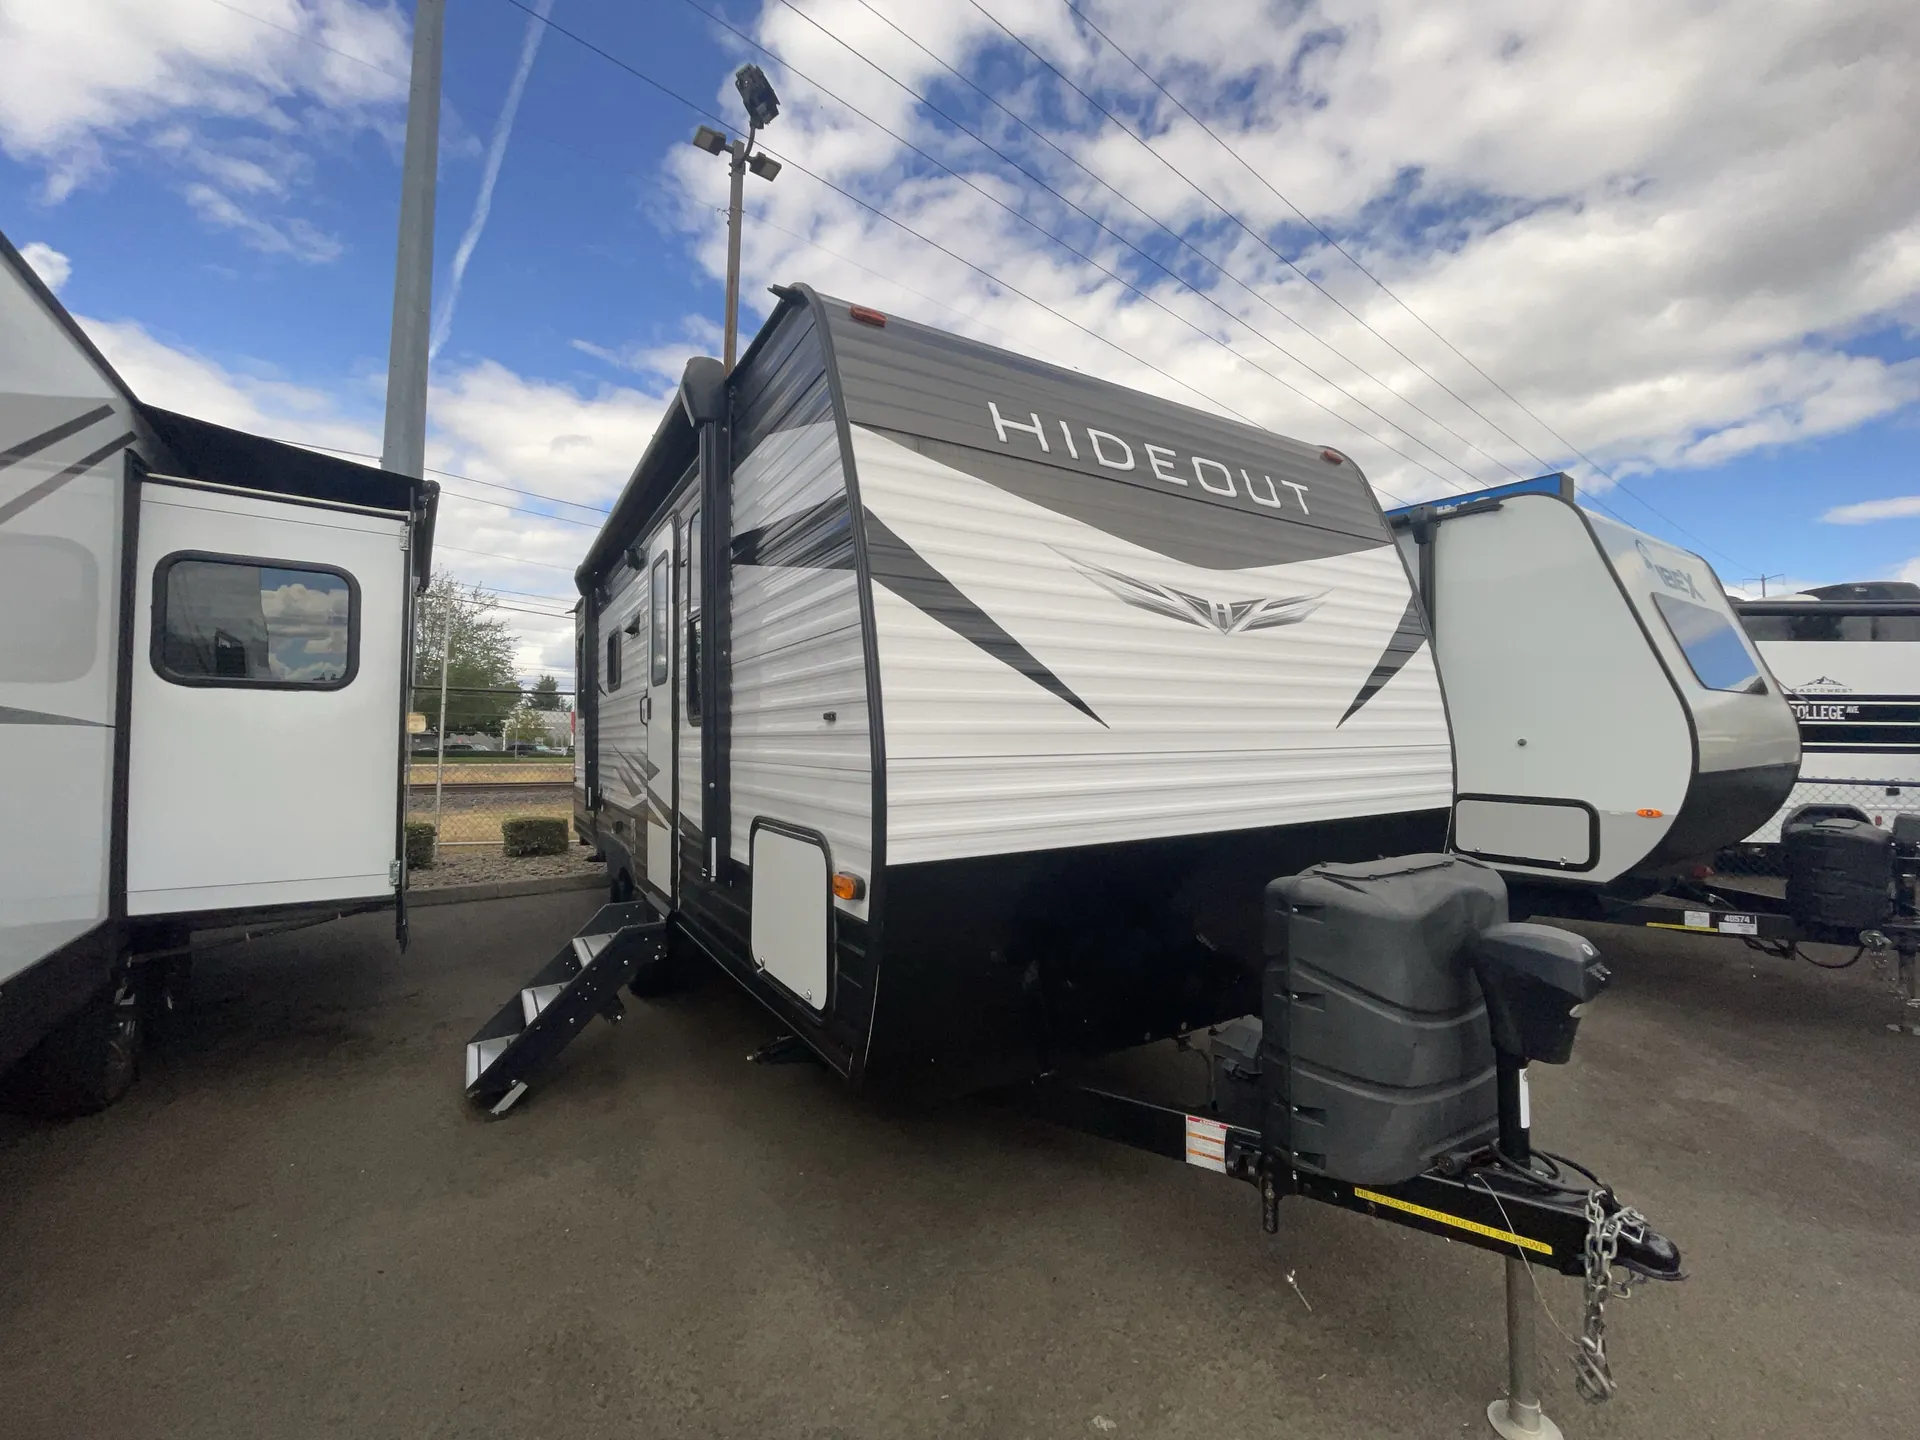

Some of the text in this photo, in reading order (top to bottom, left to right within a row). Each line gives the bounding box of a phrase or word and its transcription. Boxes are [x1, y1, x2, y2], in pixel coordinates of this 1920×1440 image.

[987, 401, 1311, 516] HIDEOUT
[1653, 564, 1706, 602] IBEX
[1846, 705, 1860, 714] AVE
[1420, 1208, 1444, 1221] 2020
[1446, 1214, 1491, 1235] HIDEOUT
